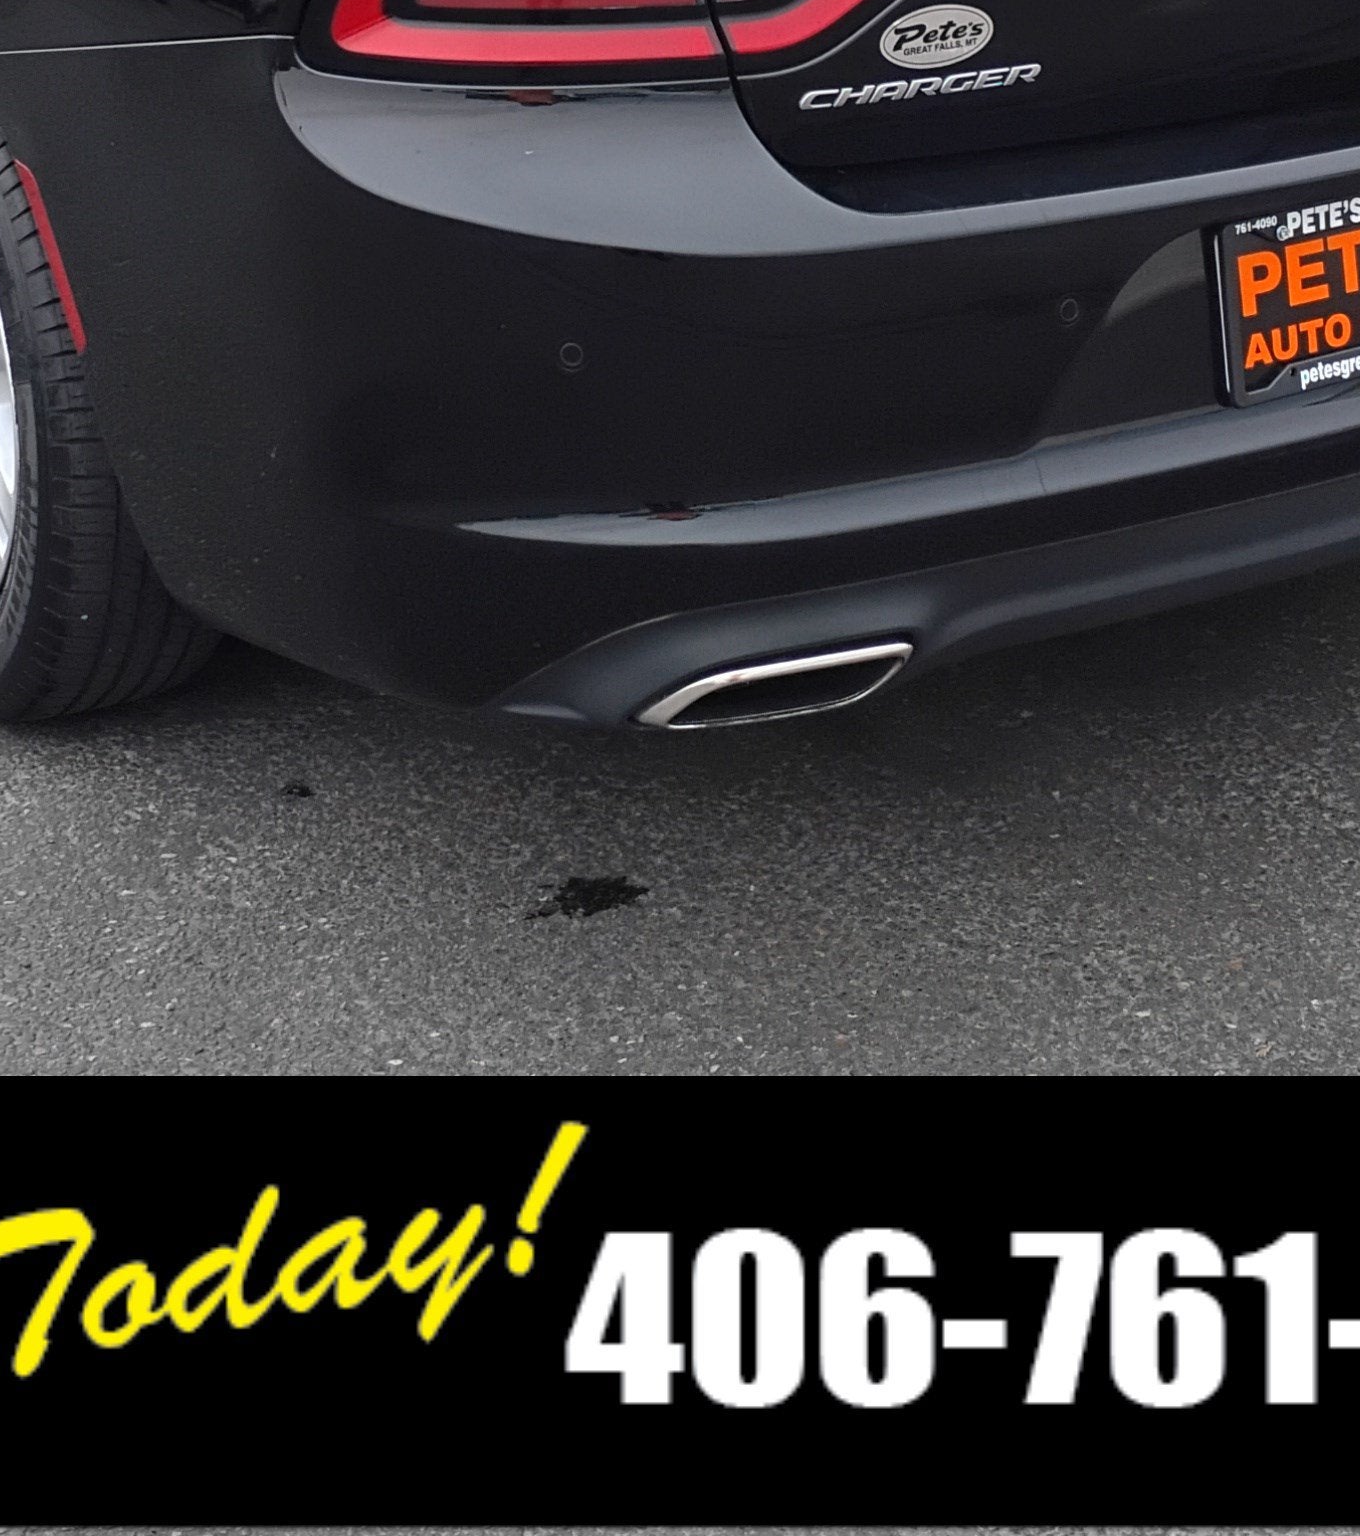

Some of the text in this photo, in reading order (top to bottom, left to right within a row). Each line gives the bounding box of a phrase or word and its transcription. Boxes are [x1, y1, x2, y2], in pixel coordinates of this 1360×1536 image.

[893, 20, 985, 52] Pete's
[903, 37, 977, 56] GREAT FALLS, MT
[798, 63, 1042, 111] CHARGER
[1234, 215, 1278, 235] 761-4090
[1244, 312, 1351, 369] AUTO
